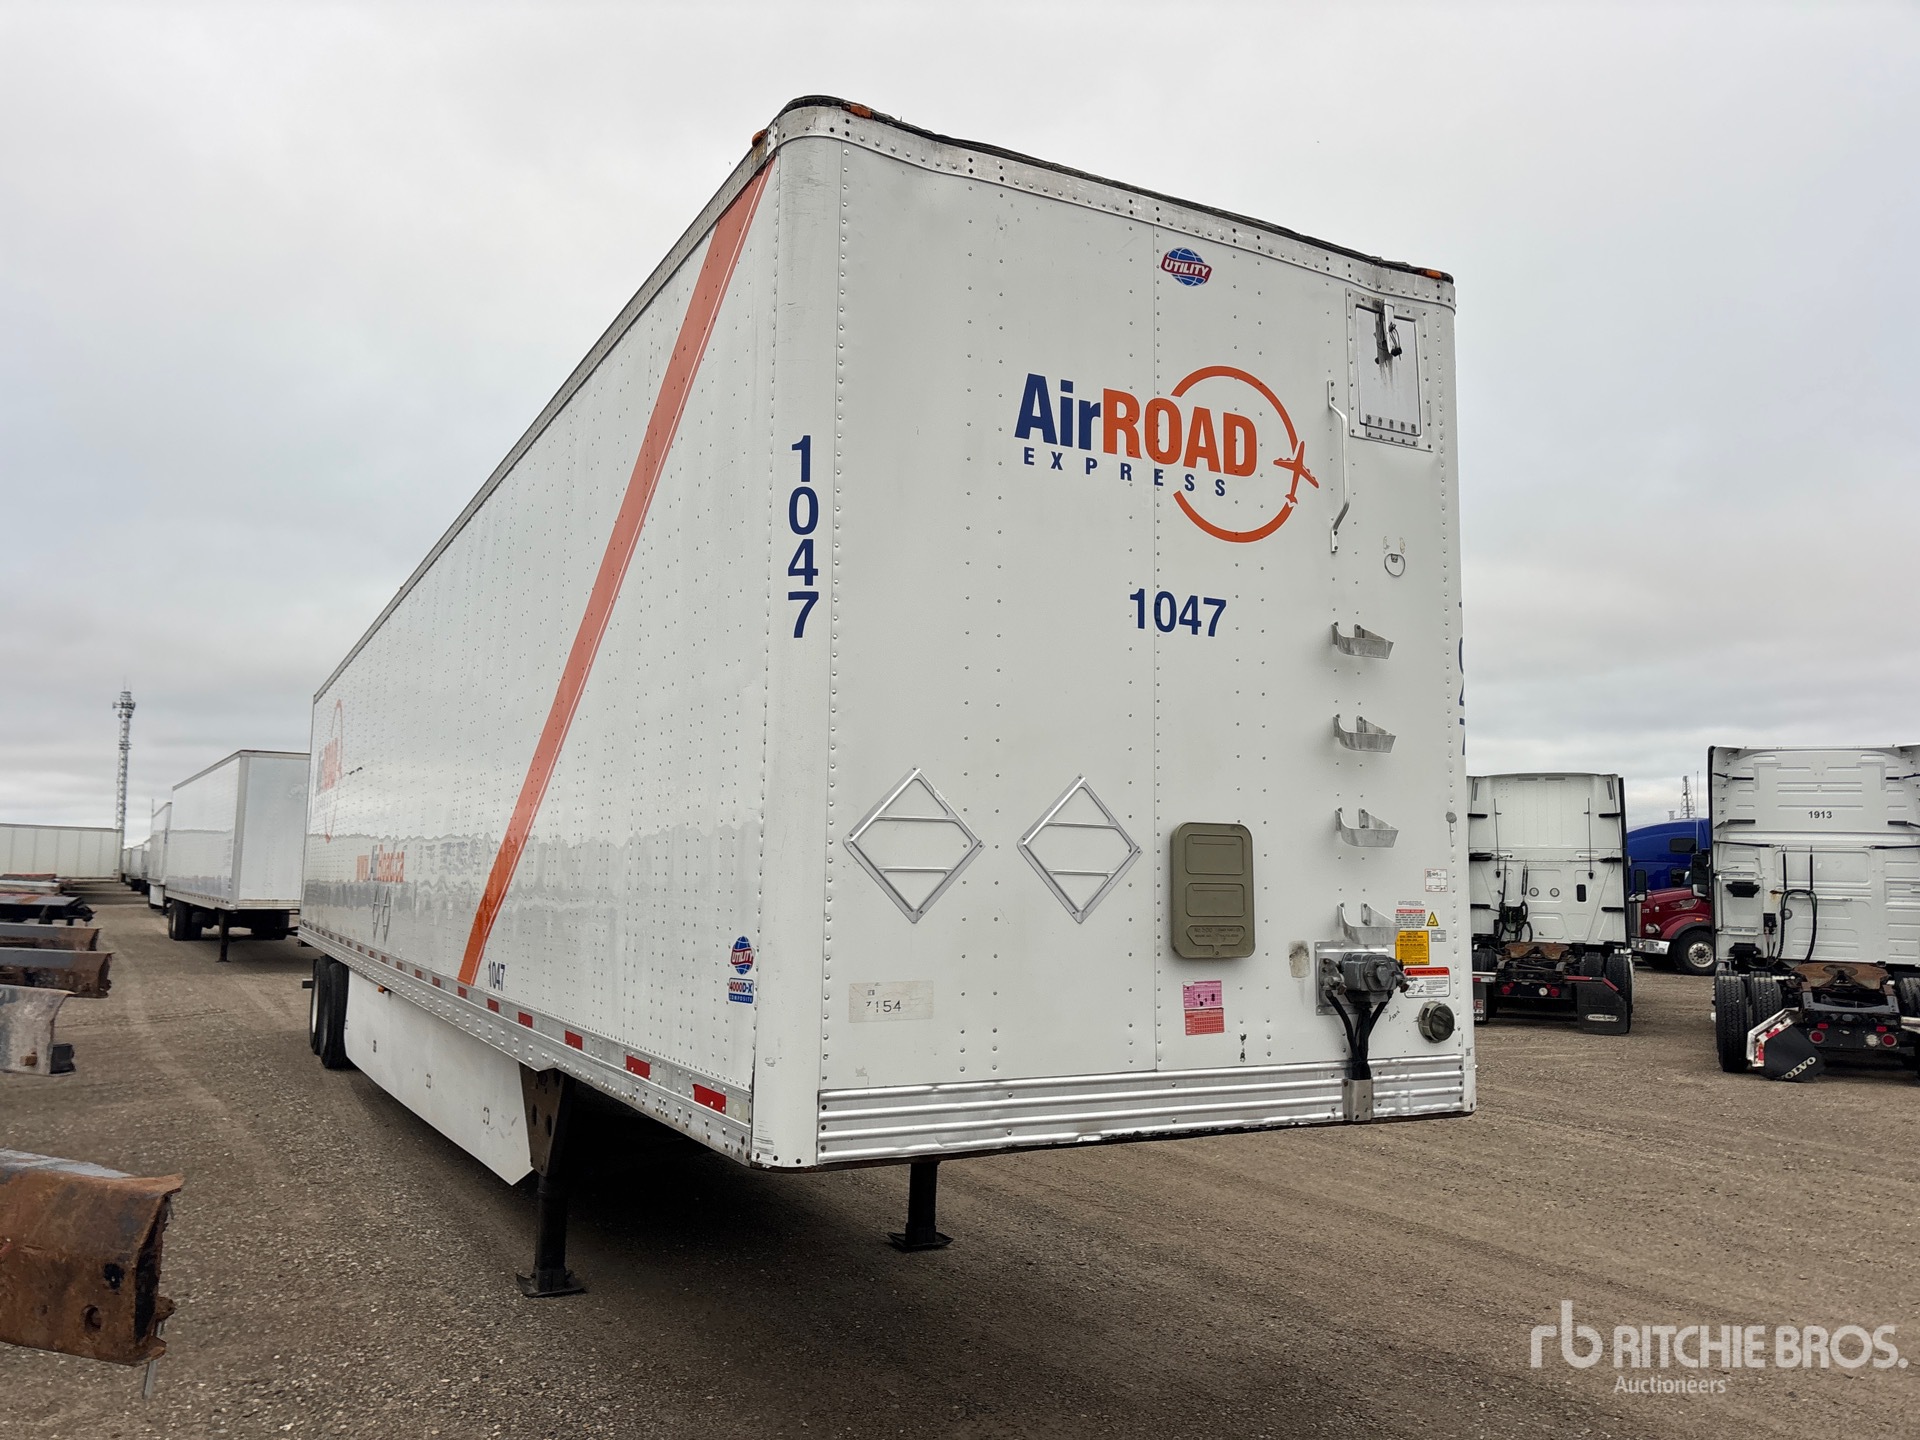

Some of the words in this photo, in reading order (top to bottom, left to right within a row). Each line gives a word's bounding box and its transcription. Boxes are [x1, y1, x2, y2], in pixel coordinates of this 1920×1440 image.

[1164, 258, 1210, 277] UTILITY
[1014, 373, 1257, 477] AirROAD
[1023, 447, 1226, 497] EXPRESS
[788, 435, 819, 638] 1047
[1130, 588, 1227, 637] 1047
[1808, 810, 1833, 819] 1913
[731, 949, 754, 964] UTILITY
[488, 960, 506, 991] 1047
[729, 981, 754, 994] 4000D-X
